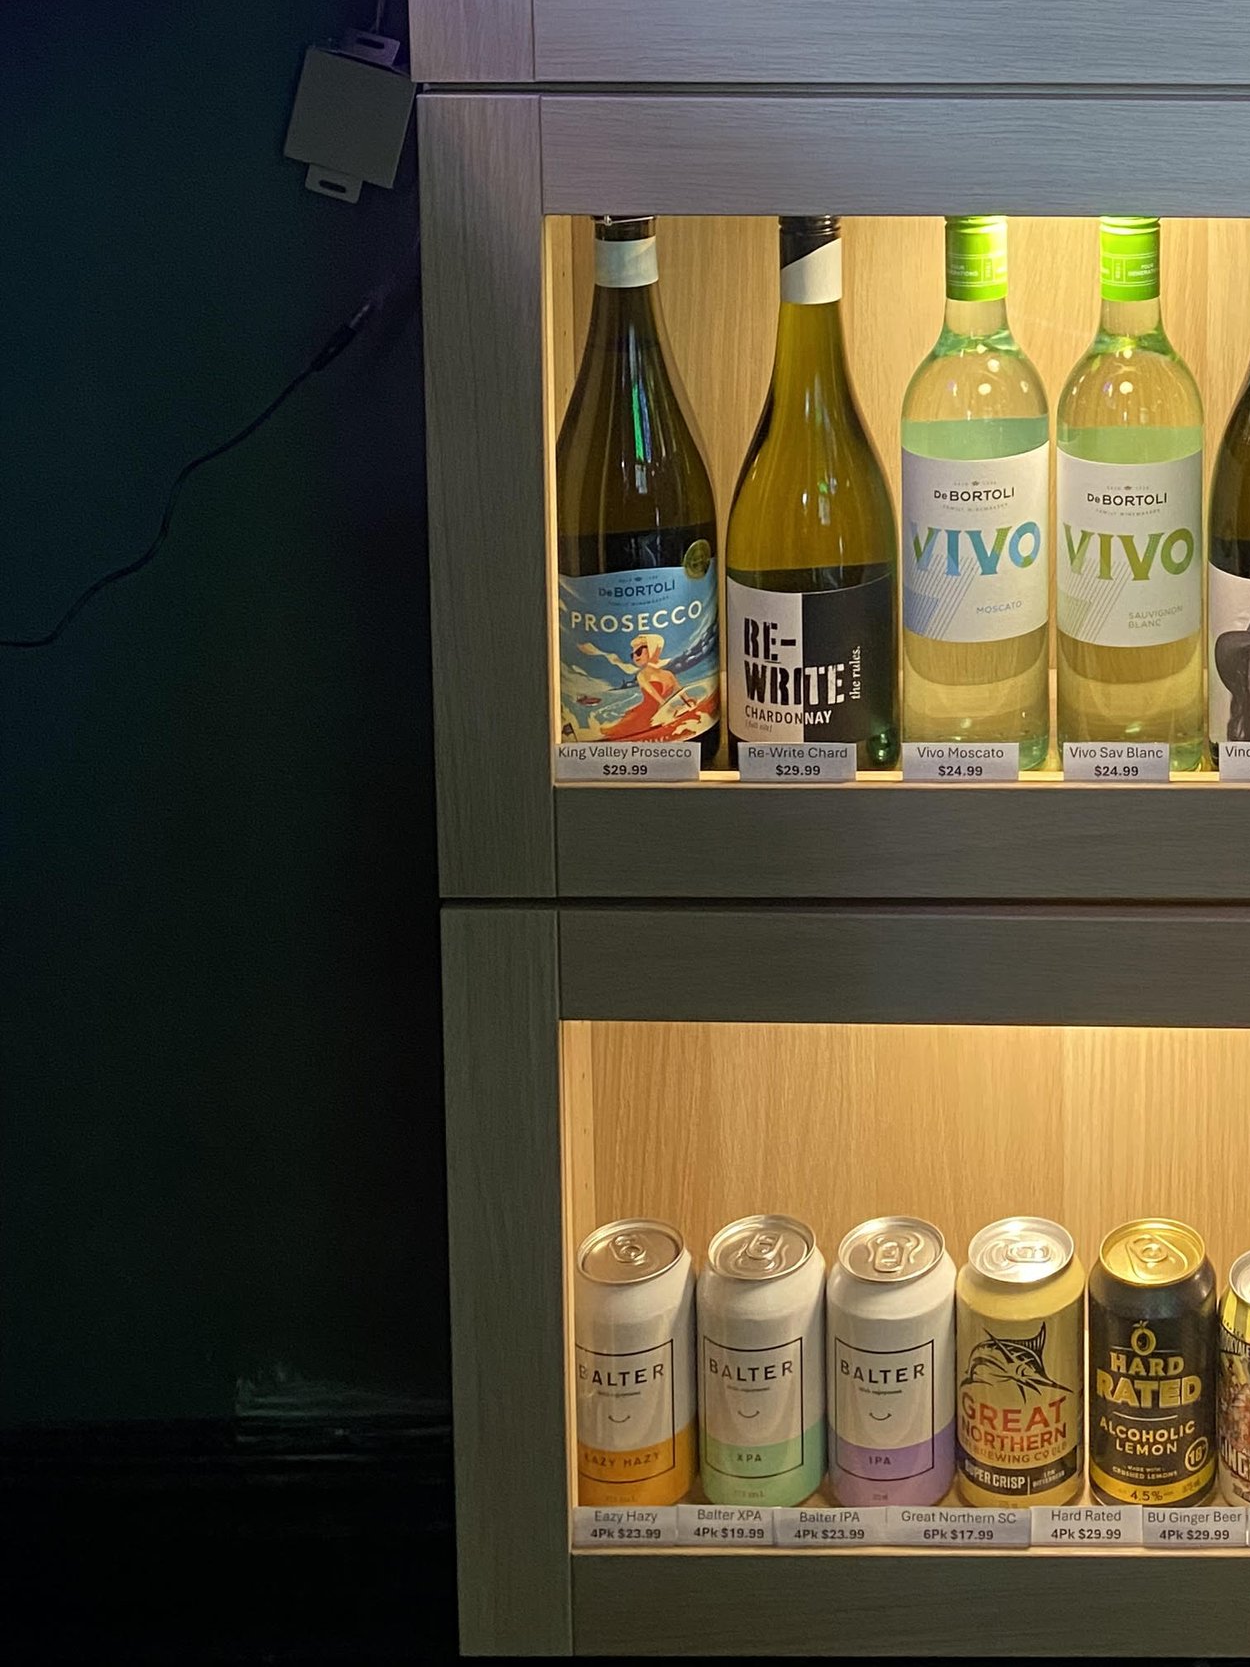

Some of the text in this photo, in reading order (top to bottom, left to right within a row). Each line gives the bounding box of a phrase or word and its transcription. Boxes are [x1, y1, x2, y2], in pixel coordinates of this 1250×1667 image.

[910, 520, 1041, 577] VIVO
[1063, 522, 1195, 581] VIVO
[976, 600, 1023, 615] MOSCATO
[1128, 604, 1184, 620] SAUVIGNON
[570, 600, 702, 633] PROSECCO
[1128, 618, 1162, 629] BLANC
[743, 617, 797, 662] RE-
[849, 645, 861, 700] the rules.
[744, 659, 845, 706] WRITE
[745, 705, 832, 725] CHARDONNAY
[558, 746, 692, 761] King Valley Prosecco
[917, 746, 1005, 759] Vivo Moscato
[1069, 746, 1164, 759] Vivo Sav Blanc
[602, 763, 648, 777] $29.99
[775, 764, 821, 777] $29.99
[938, 765, 983, 778] $24.99
[1094, 765, 1139, 778] $24.99
[708, 1357, 794, 1383] BALTER
[840, 1358, 926, 1385] BALTER
[1109, 1351, 1185, 1377] HARD
[578, 1362, 665, 1388] BALTER
[1096, 1367, 1203, 1409] RATED
[961, 1392, 1067, 1434] GREAT
[961, 1421, 1067, 1453] NORTHERN
[1100, 1415, 1196, 1444] ALCOHOLIC
[1115, 1436, 1178, 1457] LEMON
[623, 1451, 660, 1468] HAZY
[736, 1452, 763, 1464] XPA
[869, 1455, 892, 1466] IPA
[992, 1474, 1026, 1490] CRISP
[901, 1510, 1018, 1524] Great Northern SC
[1051, 1509, 1122, 1522] Hard Rated
[1147, 1511, 1242, 1526] BU Ginger Beer
